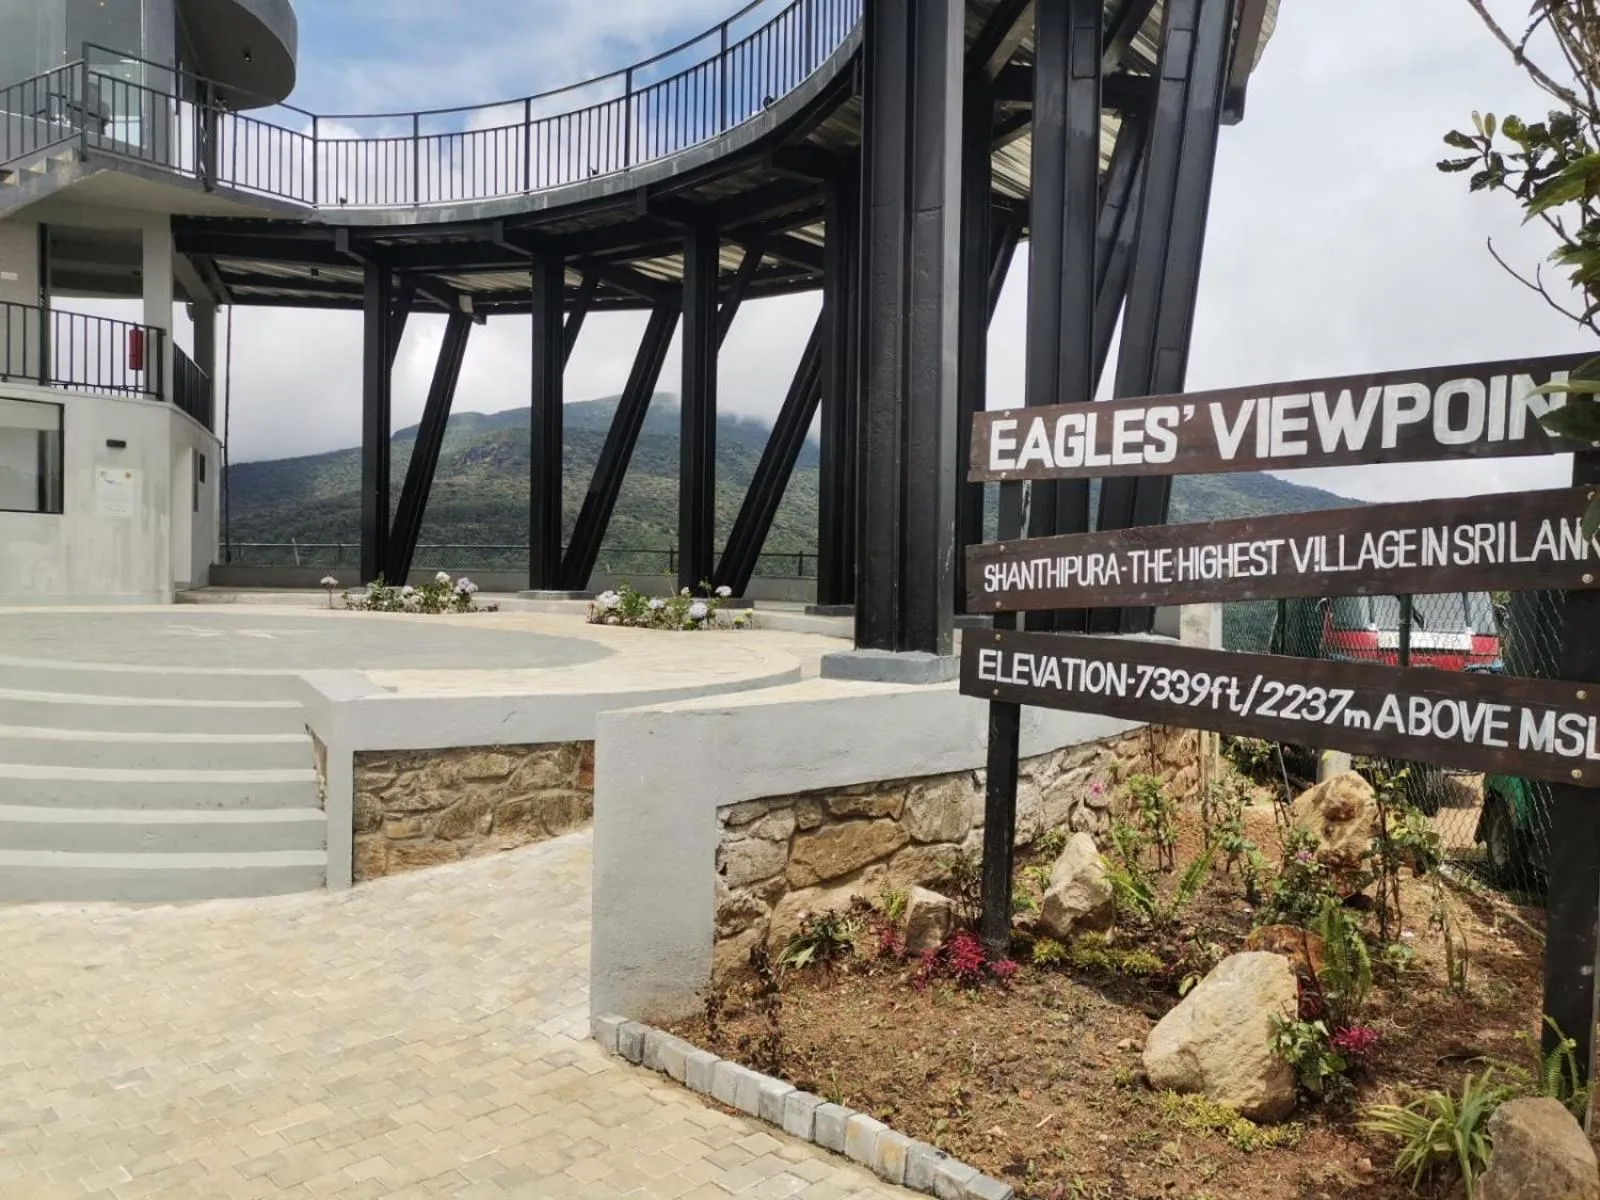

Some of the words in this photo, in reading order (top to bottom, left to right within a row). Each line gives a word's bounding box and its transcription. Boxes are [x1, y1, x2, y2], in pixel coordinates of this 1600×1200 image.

[989, 405, 1195, 471] EAGLES'
[1209, 371, 1600, 460] VIEWPOIN
[1178, 539, 1285, 582] HIGHEST
[1289, 529, 1416, 574] VILLAGE
[1421, 526, 1448, 567] IN
[1453, 521, 1505, 566] SRI
[1373, 694, 1512, 747] ABOVE
[1518, 707, 1600, 760] MSL
